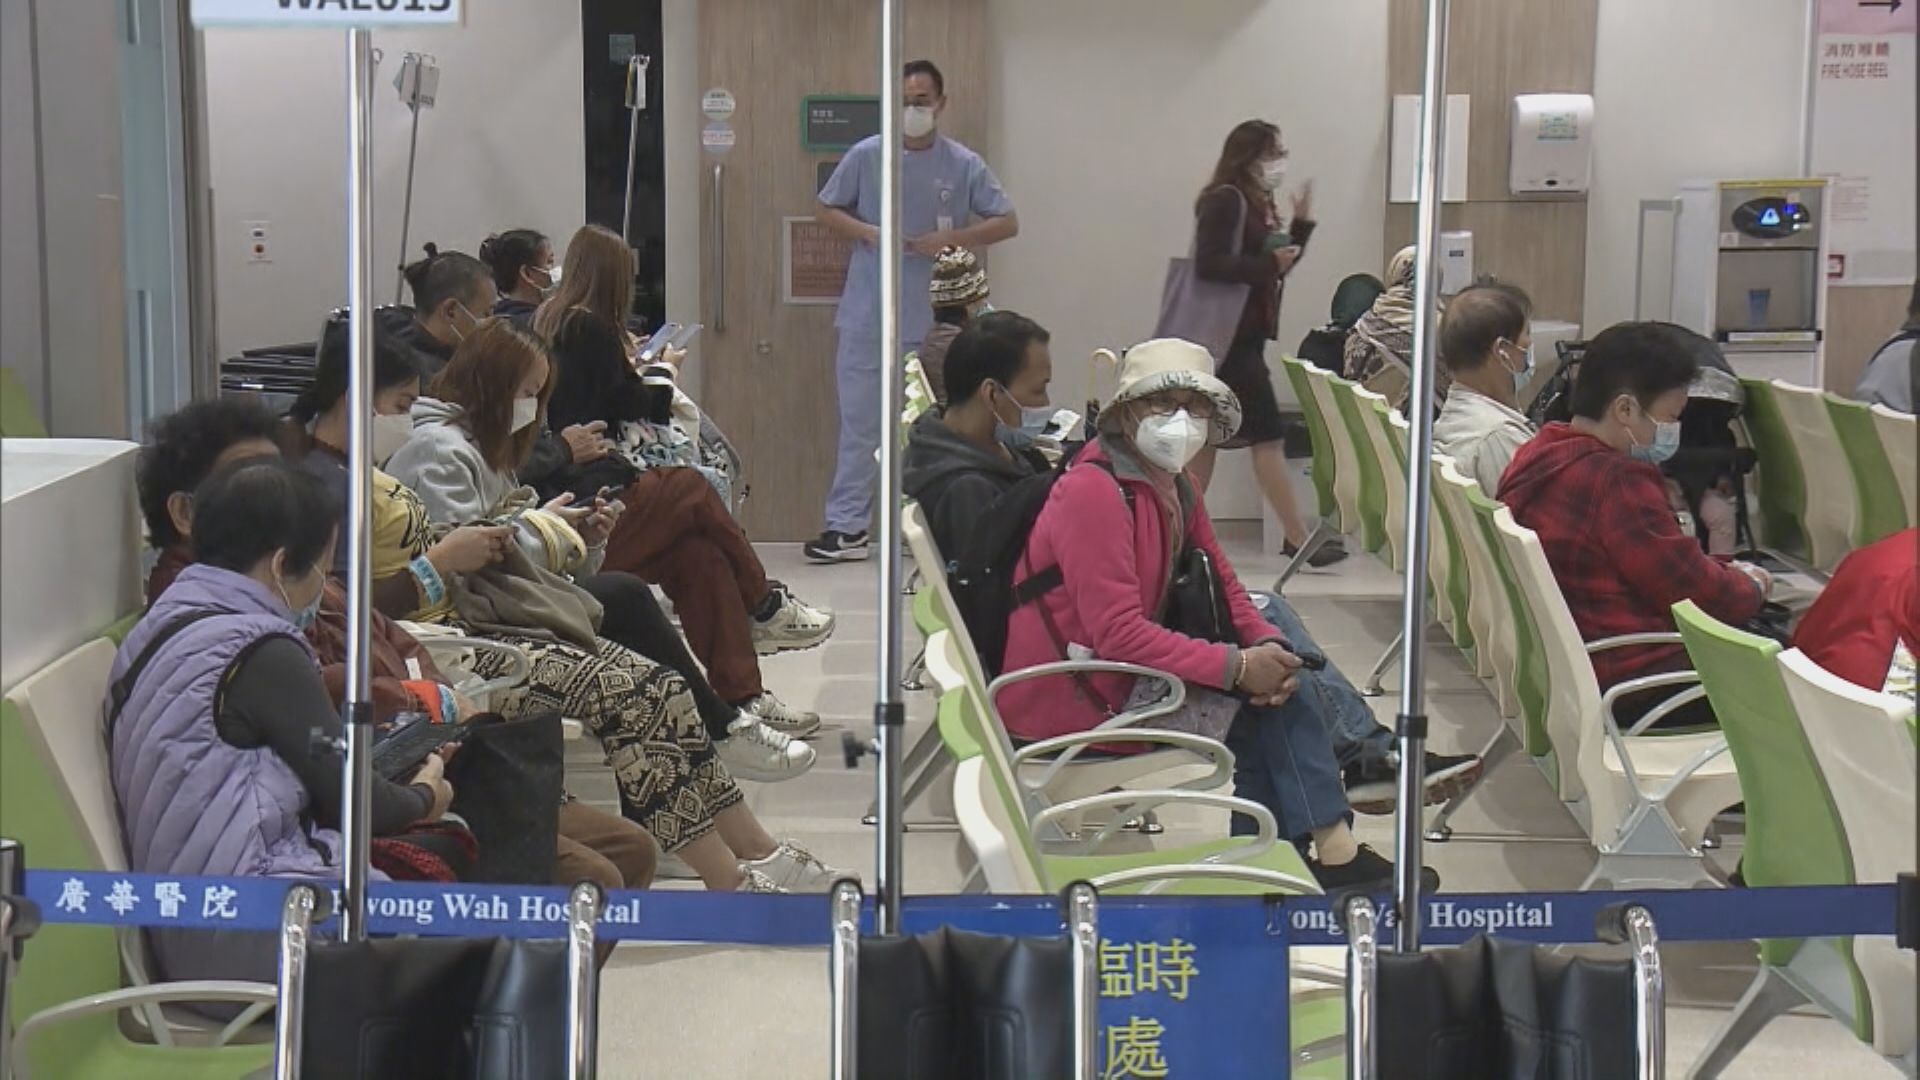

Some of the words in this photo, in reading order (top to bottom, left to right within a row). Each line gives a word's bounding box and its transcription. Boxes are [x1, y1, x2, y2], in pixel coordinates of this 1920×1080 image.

[55, 878, 239, 920] 廣華醫院
[442, 893, 509, 921] Wah
[519, 895, 641, 924] Hostal
[1429, 901, 1554, 933] Hospital
